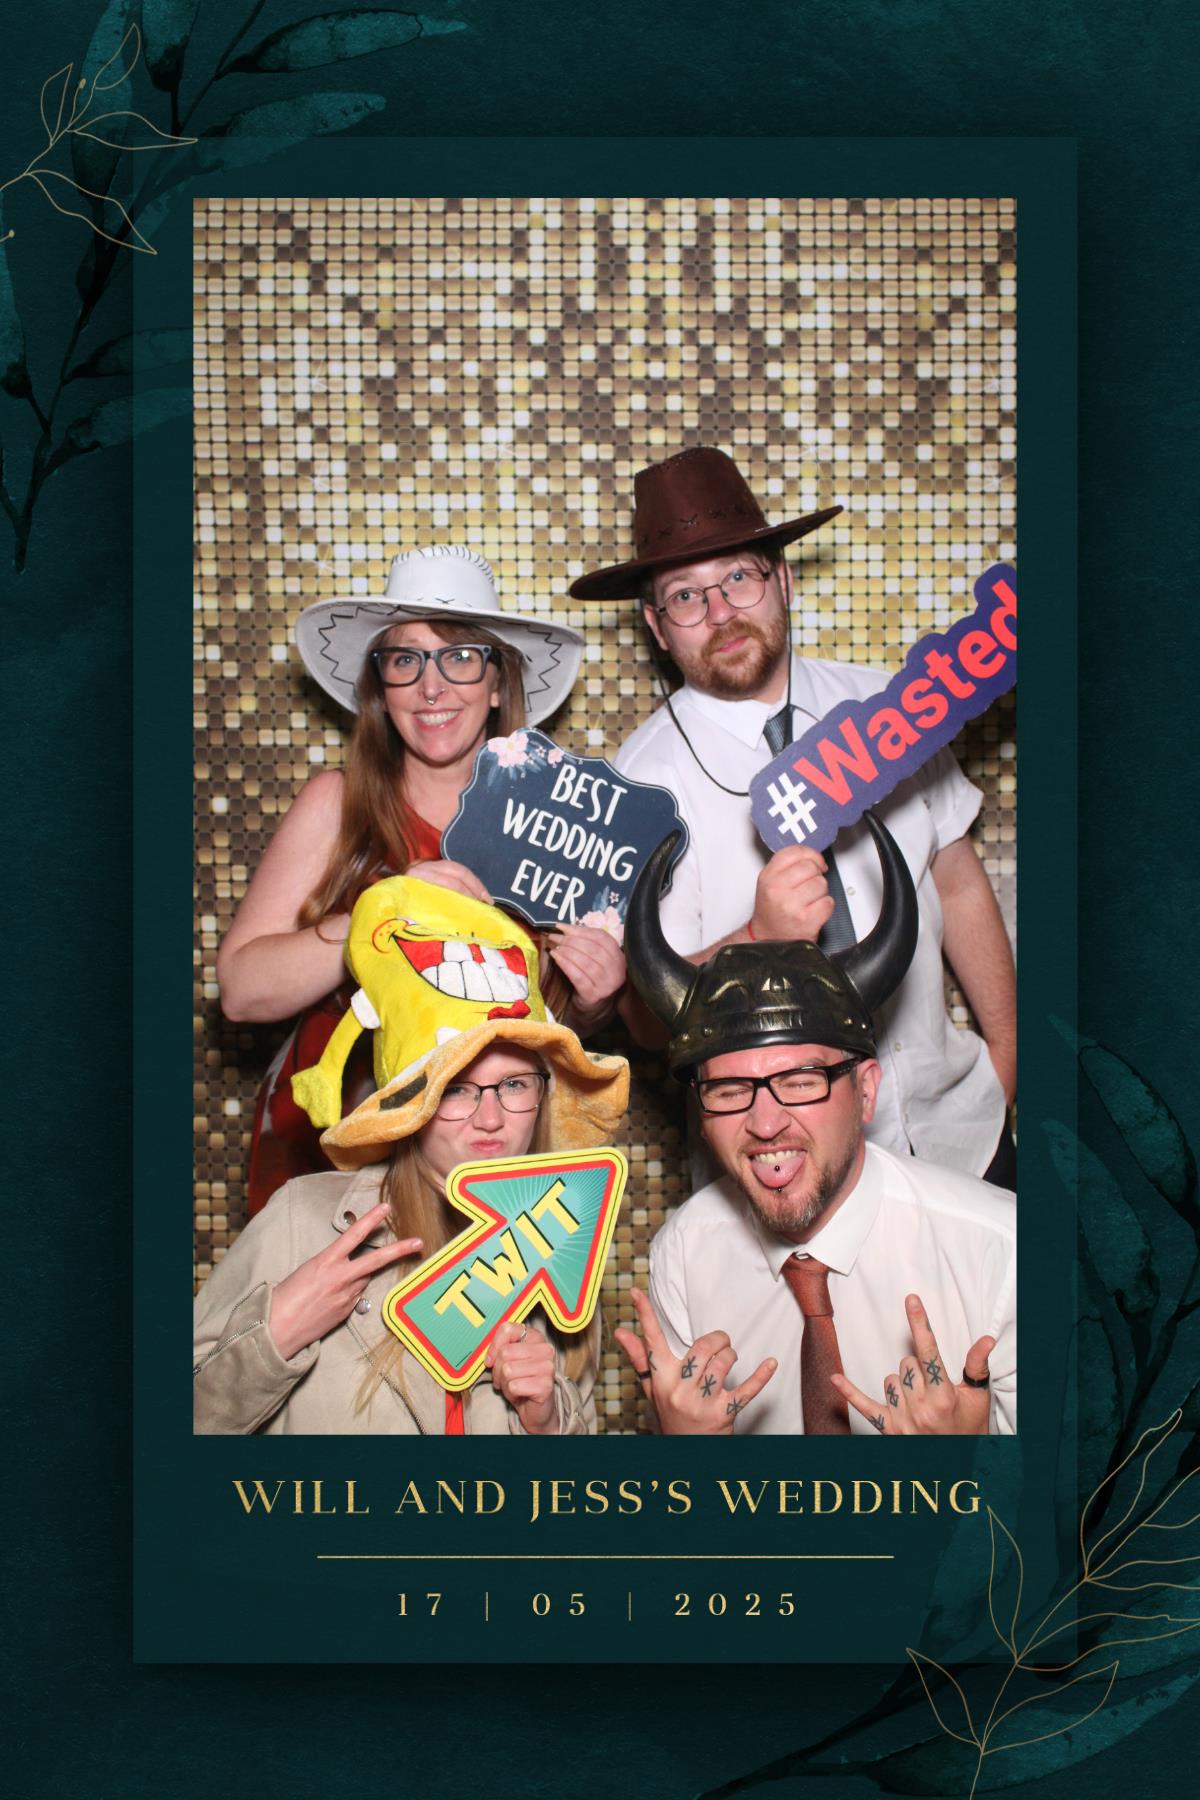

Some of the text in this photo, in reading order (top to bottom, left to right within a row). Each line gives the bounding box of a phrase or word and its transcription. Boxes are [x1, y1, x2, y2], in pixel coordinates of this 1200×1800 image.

[550, 763, 628, 826] BEST
[502, 798, 638, 882] WEDDING
[510, 858, 586, 924] EVER
[433, 1177, 581, 1329] TWIT
